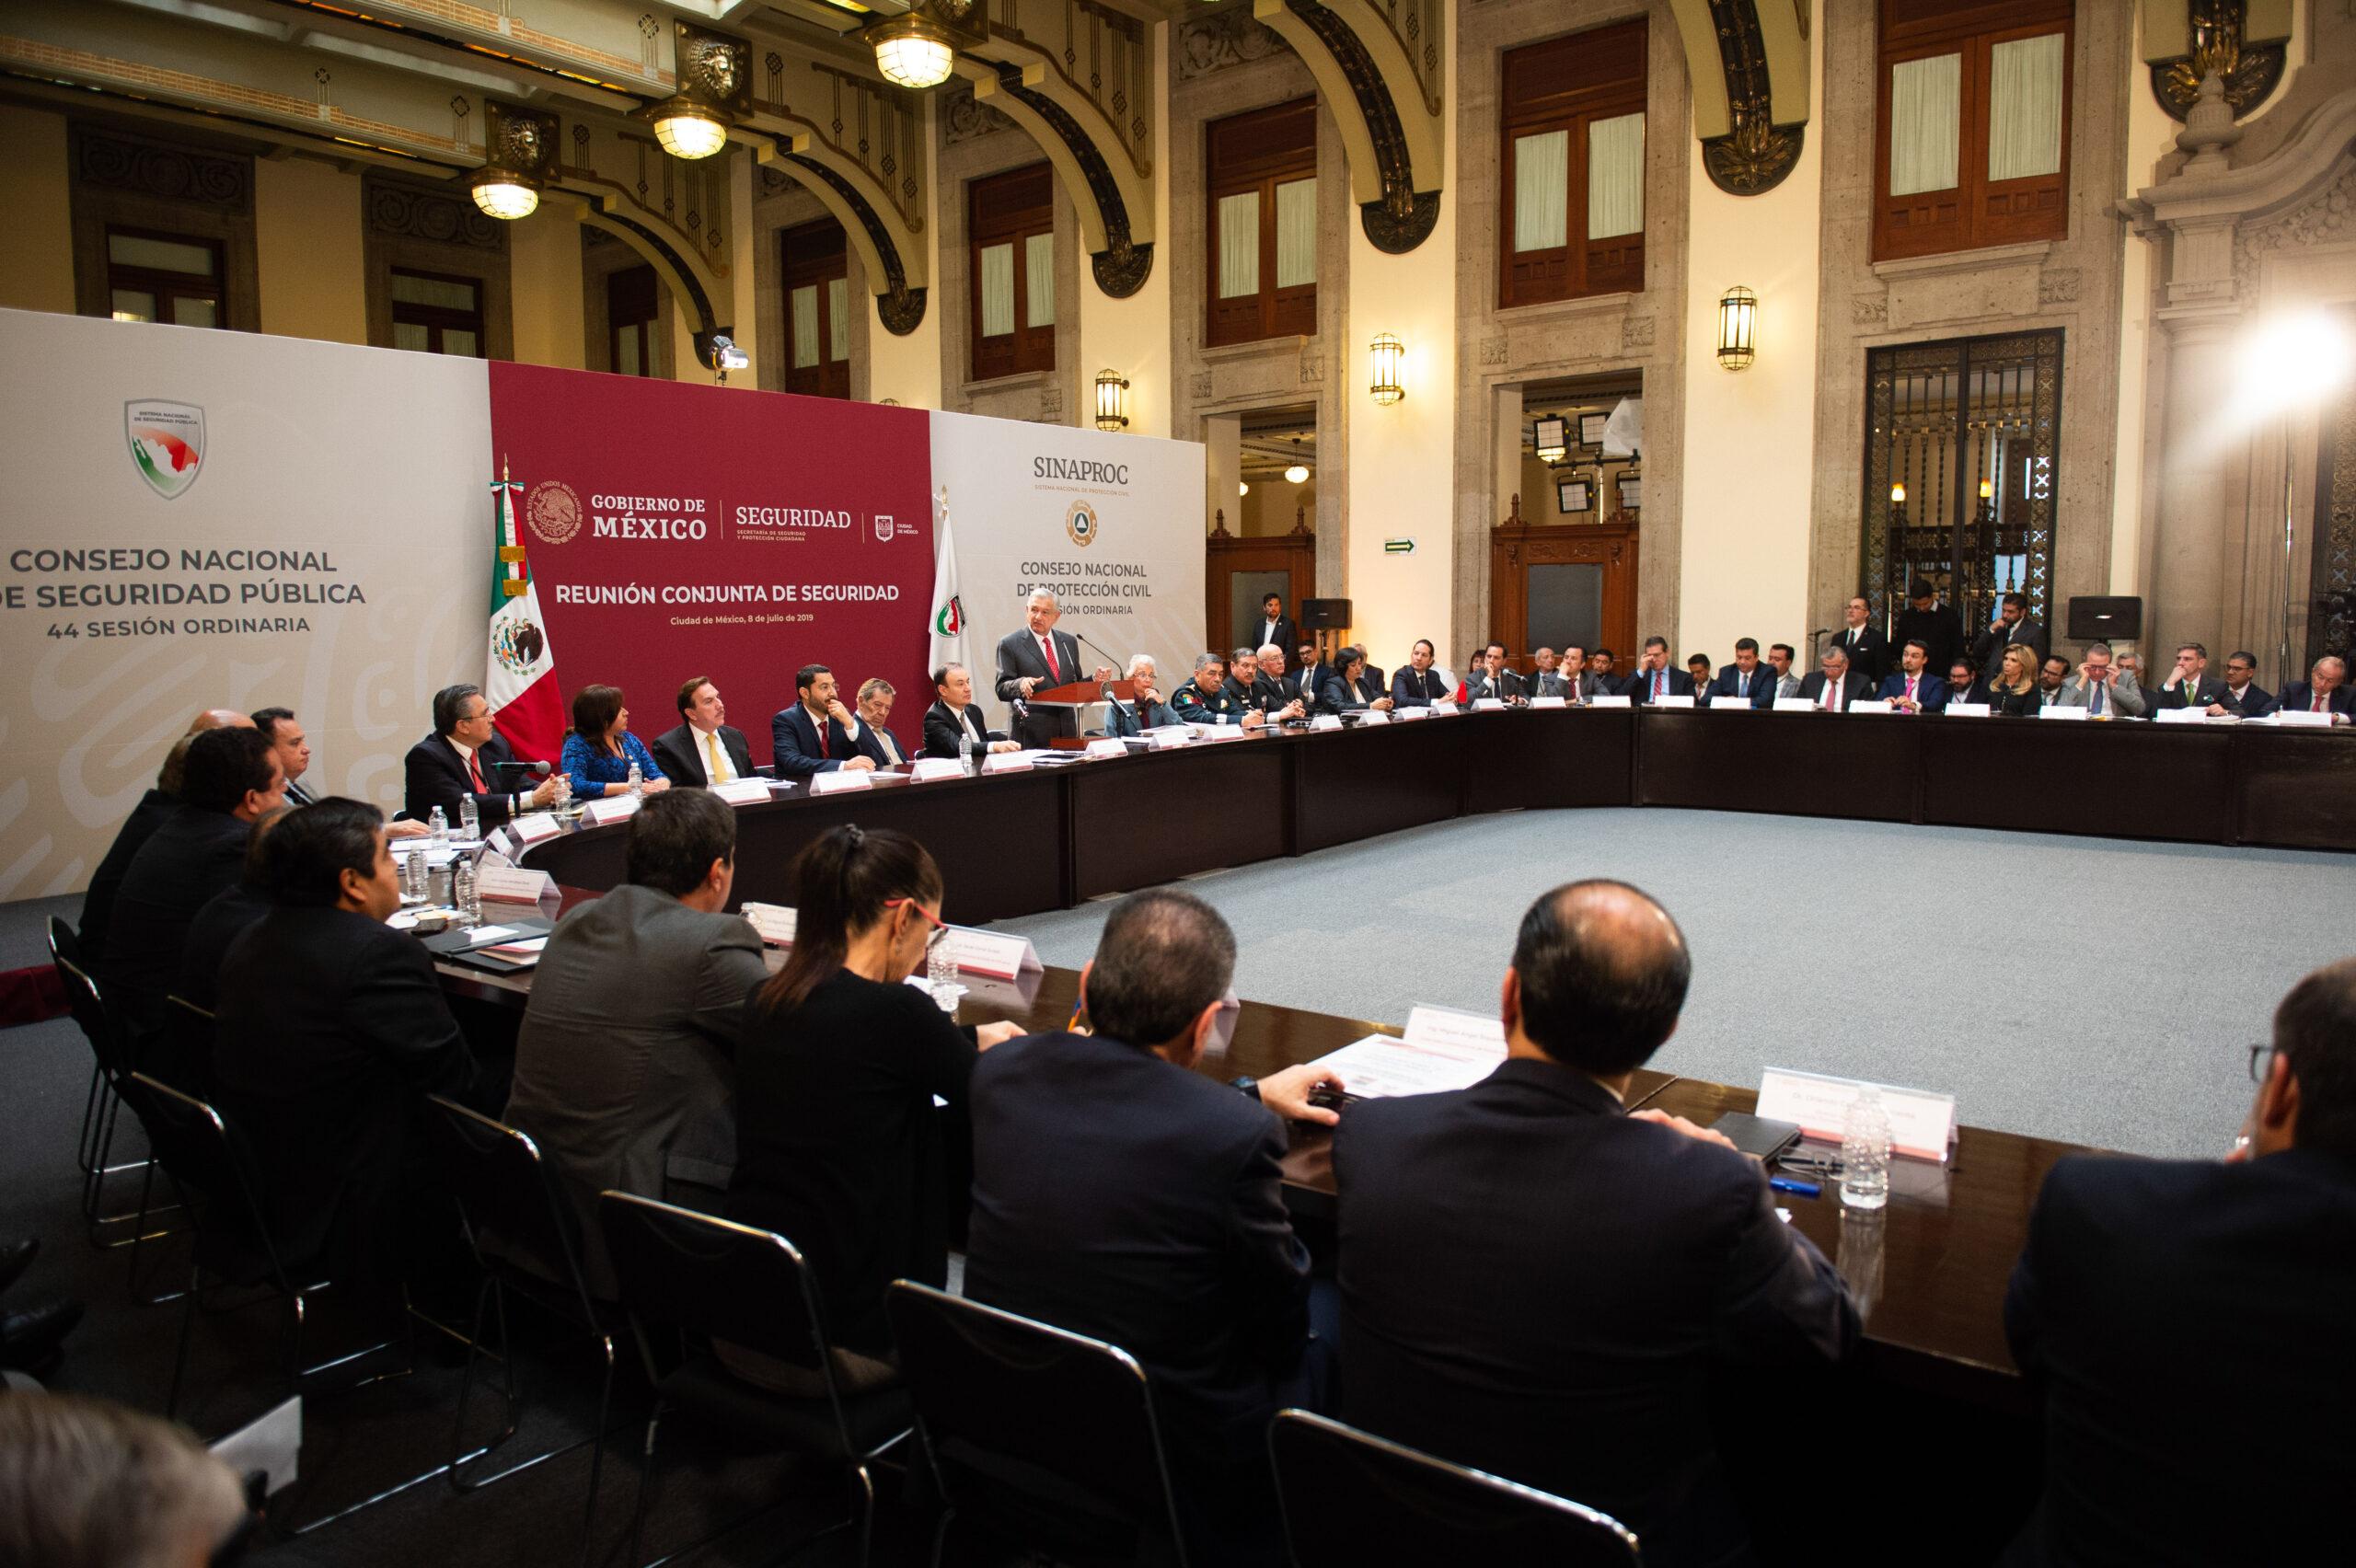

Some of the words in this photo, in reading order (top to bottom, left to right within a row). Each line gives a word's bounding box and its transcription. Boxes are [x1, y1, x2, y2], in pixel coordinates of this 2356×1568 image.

[1034, 456, 1128, 485] SINAPROC
[591, 494, 680, 512] GOBIERNO
[684, 499, 706, 513] DE
[593, 511, 707, 540] MÉXICO
[736, 506, 851, 528] SEGURIDAD
[10, 548, 171, 572] CONSEJO
[181, 549, 338, 572] NACIONAL
[1021, 561, 1081, 576] CONSEJO
[1085, 562, 1147, 578] NACIONAL
[0, 586, 27, 608] E
[36, 583, 231, 608] SEGURIDAD
[240, 578, 366, 605] PÚBLICA
[556, 582, 656, 605] REUNIÓN
[661, 584, 768, 604] CONJUNTA
[771, 585, 797, 602] DE
[801, 584, 899, 603] SEGURIDAD
[1122, 583, 1151, 597] CIVIL
[670, 616, 701, 626] Ciudad
[702, 616, 713, 625] de
[715, 615, 746, 624] México,
[747, 615, 754, 623] 8
[755, 615, 766, 623] de
[767, 614, 784, 624] julio
[785, 614, 796, 622] de
[796, 614, 814, 622] 2019
[1082, 605, 1133, 616] ORDINARIA
[47, 622, 79, 640] 44
[87, 616, 175, 638] SESIÓN
[183, 617, 311, 634] ORDINARIA
